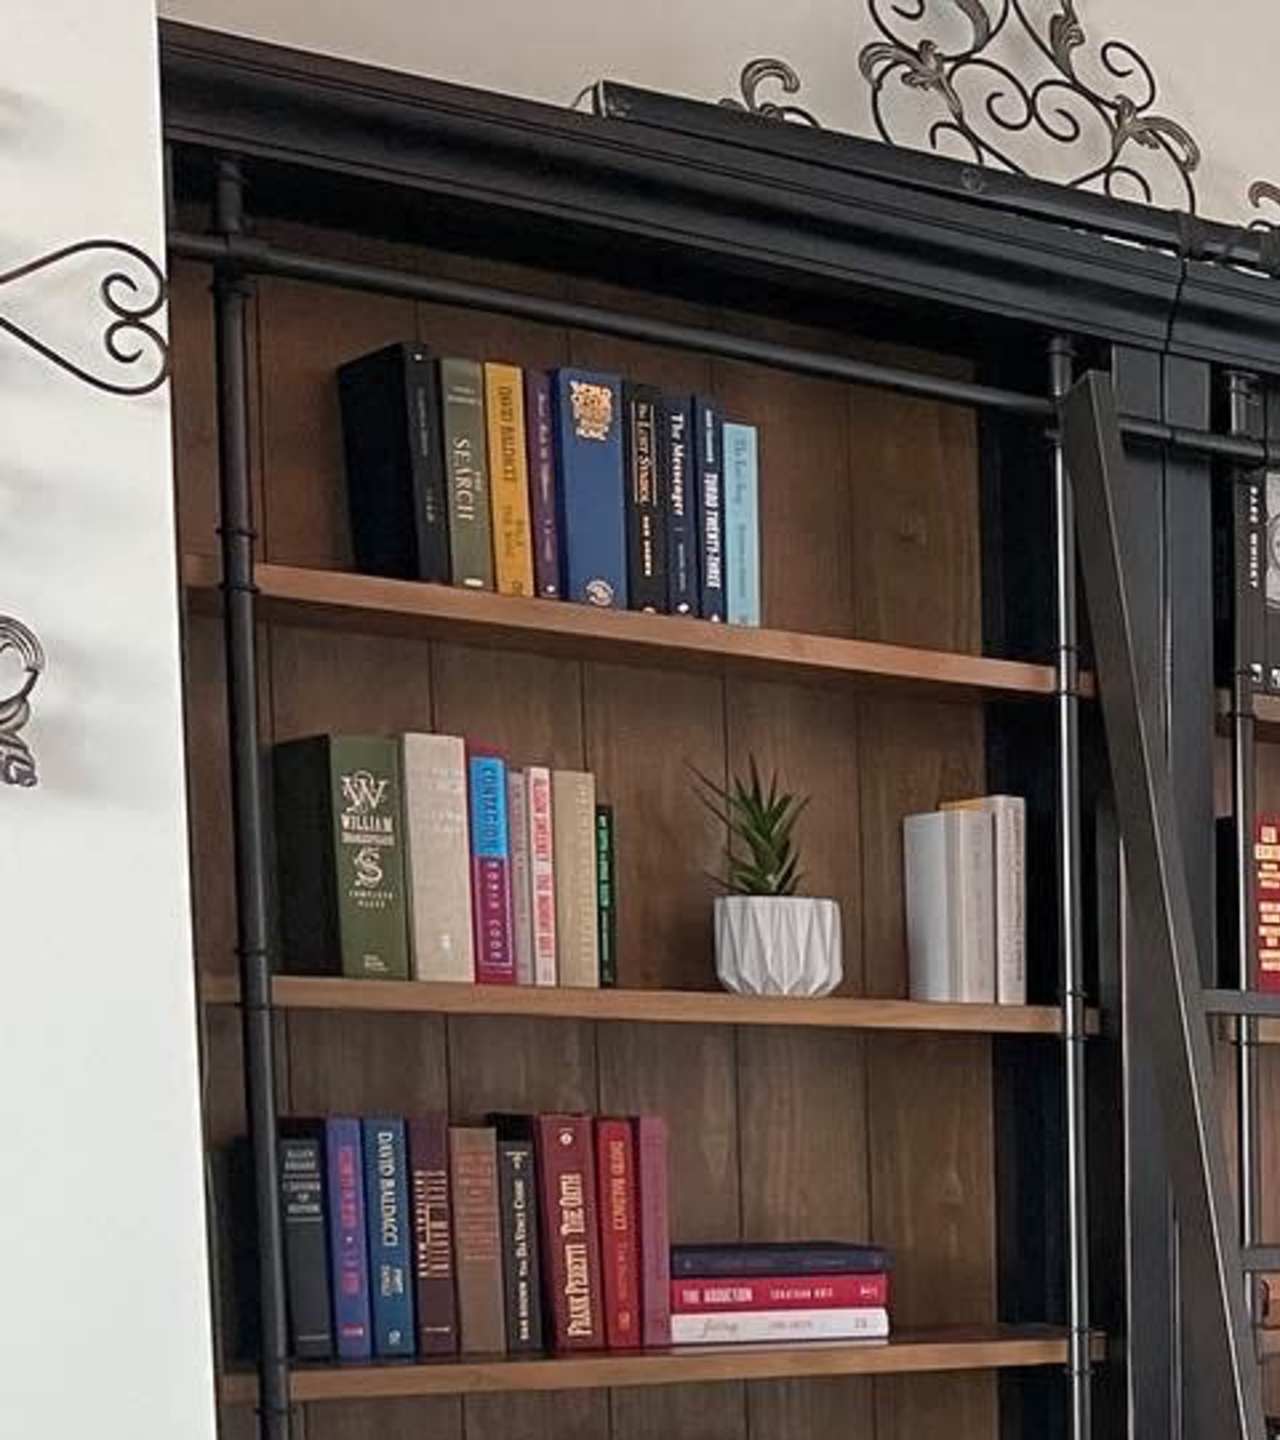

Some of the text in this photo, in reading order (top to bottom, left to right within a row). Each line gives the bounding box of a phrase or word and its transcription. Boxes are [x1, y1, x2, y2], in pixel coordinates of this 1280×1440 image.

[453, 435, 476, 521] SEARCH
[669, 412, 685, 517] The Messenger
[341, 815, 393, 832] WILLIAM
[381, 1178, 399, 1246] BALDACCI
[558, 1173, 585, 1236] THE OATH
[564, 1243, 593, 1337] FRANK PERETTI
